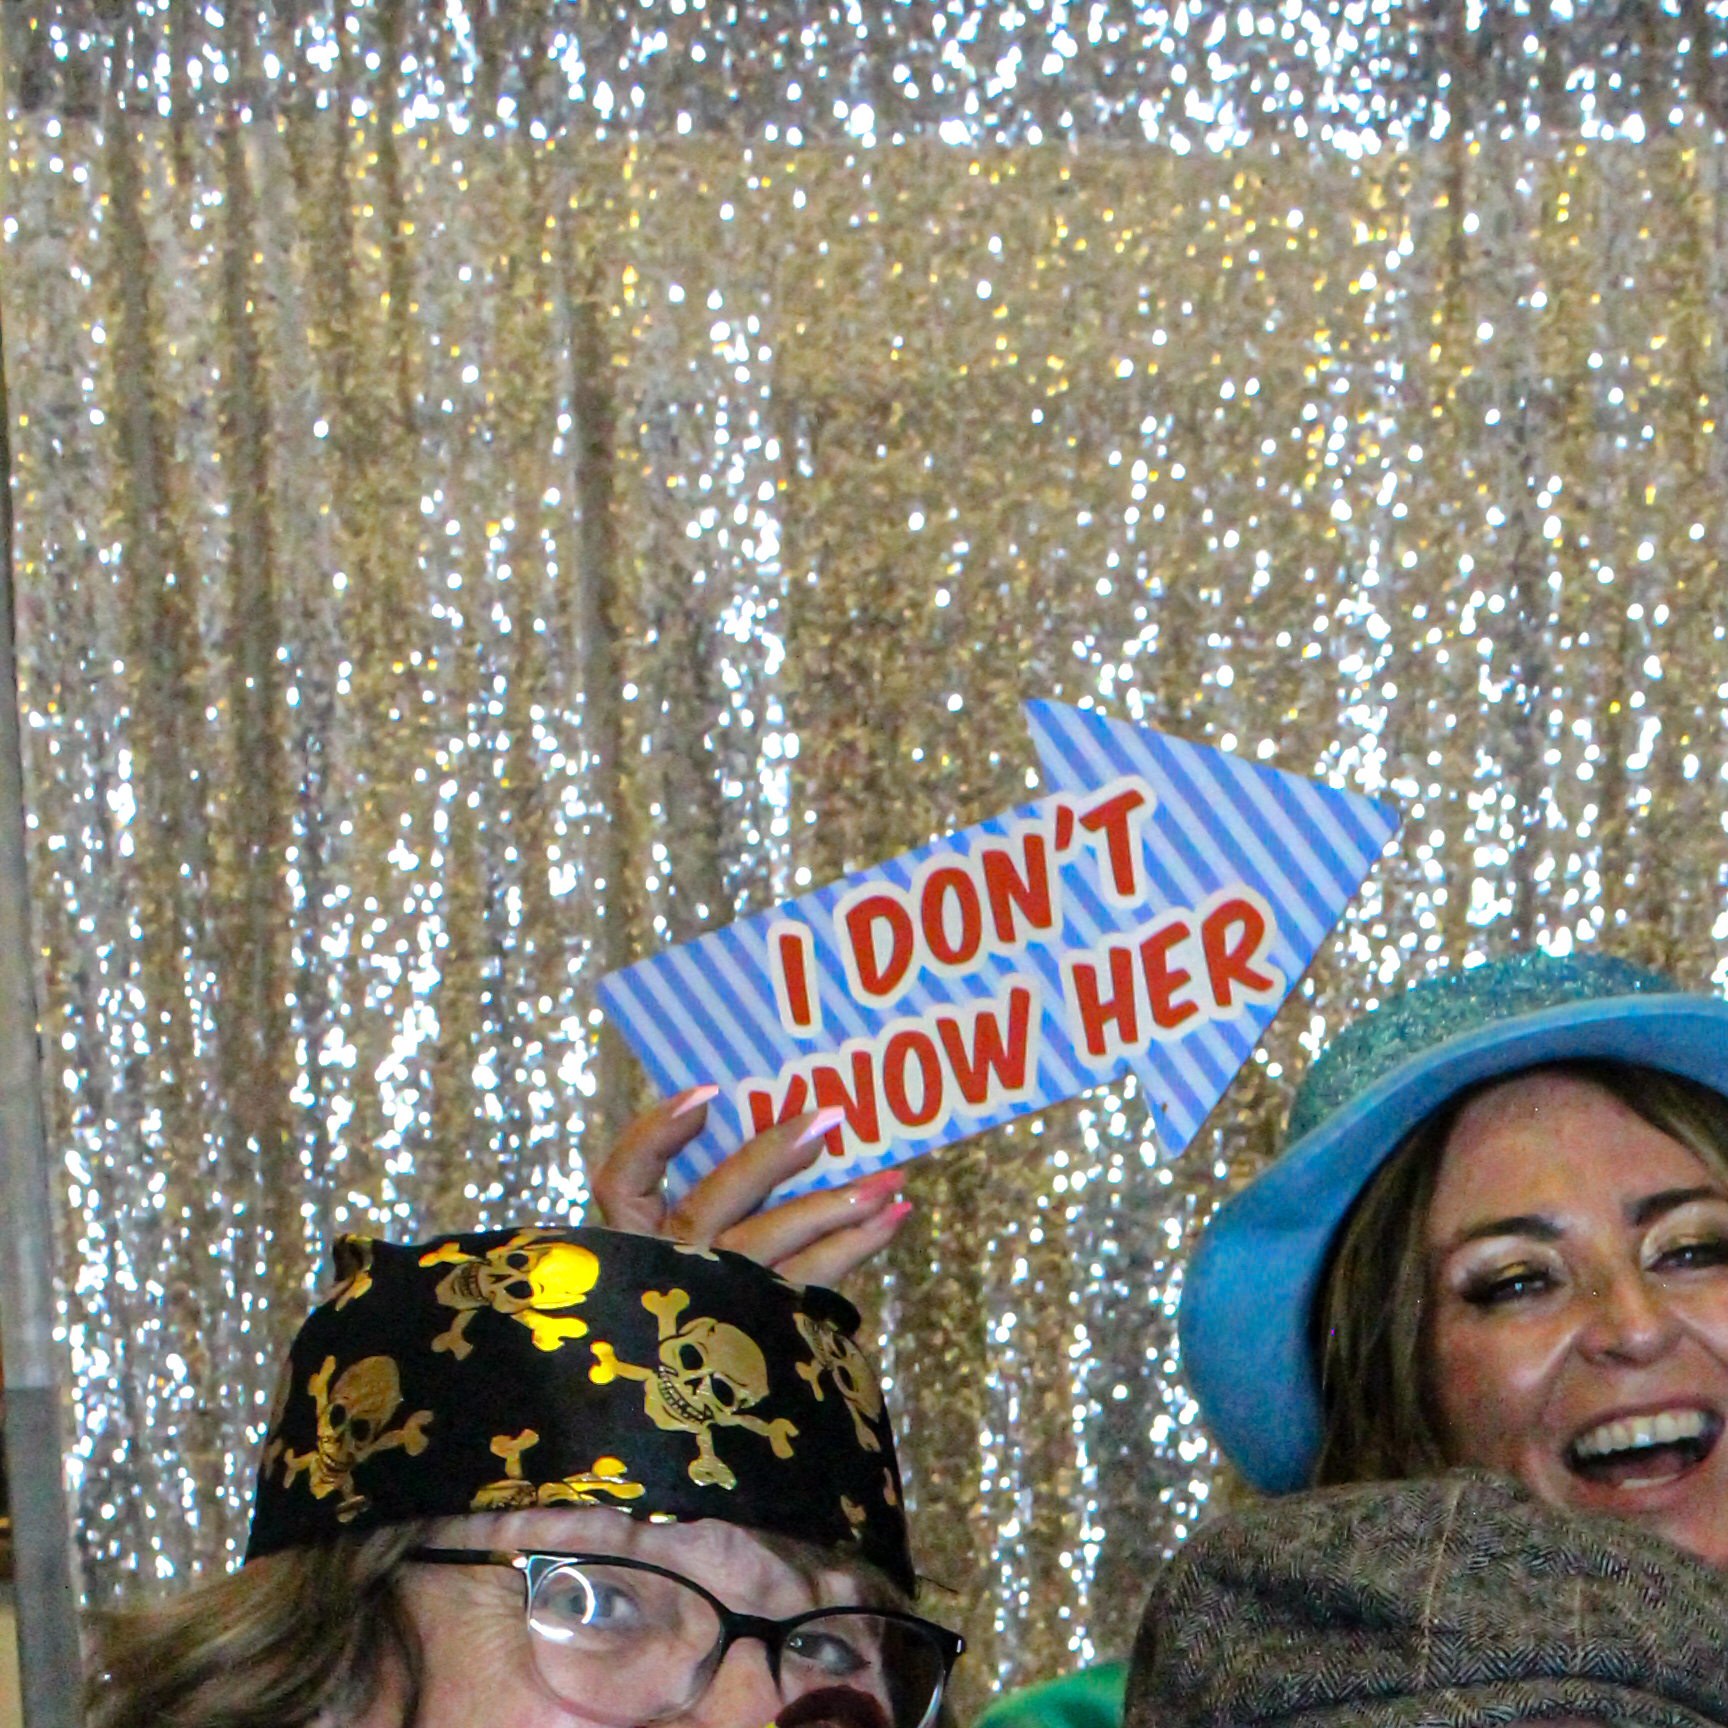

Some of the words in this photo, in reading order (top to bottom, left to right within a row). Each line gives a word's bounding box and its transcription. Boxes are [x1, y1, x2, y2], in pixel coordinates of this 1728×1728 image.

[778, 934, 812, 1027] I
[845, 788, 1144, 997] DON'T
[1071, 898, 1274, 1057] HER
